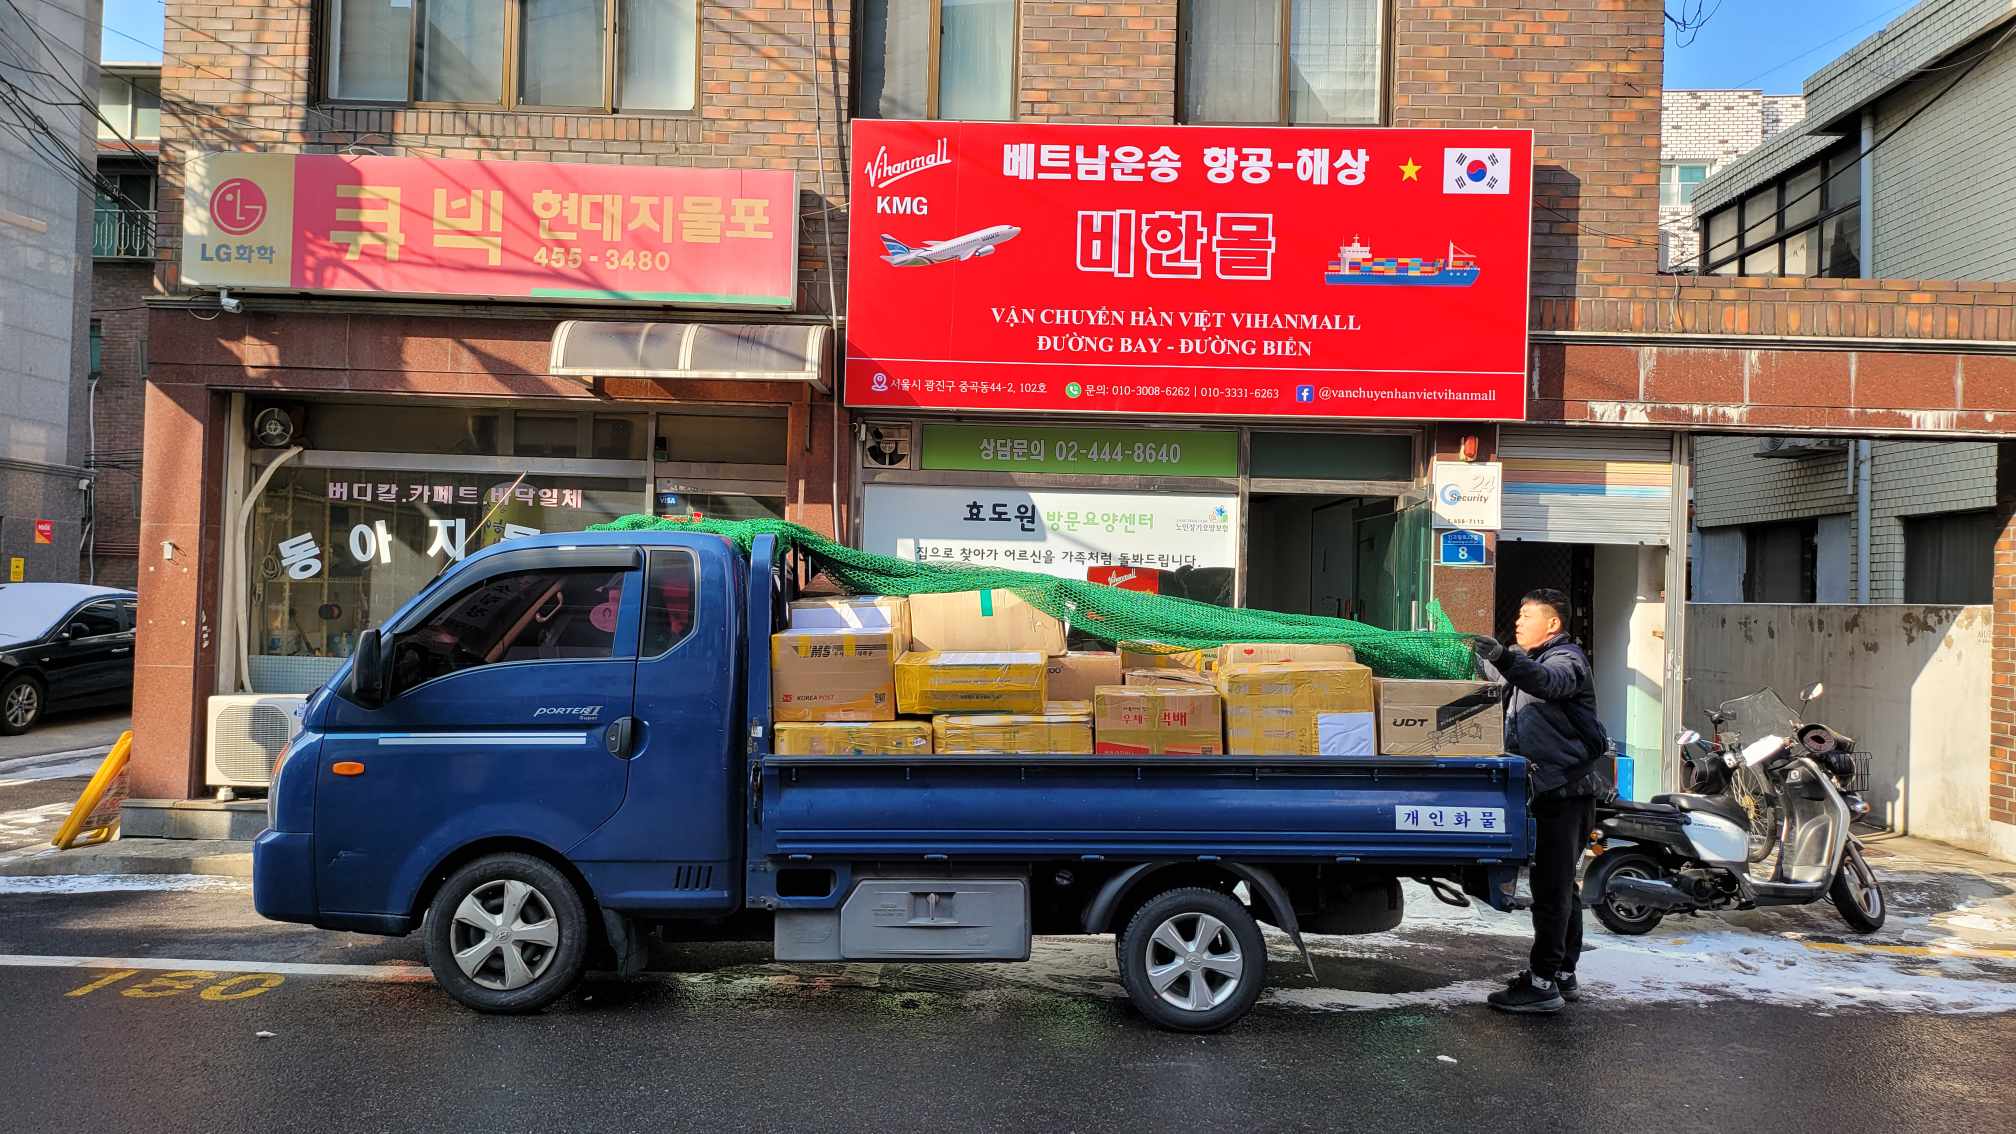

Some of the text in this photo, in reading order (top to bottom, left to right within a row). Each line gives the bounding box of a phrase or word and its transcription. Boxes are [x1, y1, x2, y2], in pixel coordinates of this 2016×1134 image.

[864, 137, 952, 189] Vihanmall
[1003, 143, 1370, 186] 베트남운송 항공-해상
[532, 189, 774, 244] 현대지물포
[876, 196, 928, 216] KMG
[200, 243, 276, 265] LG화학
[1077, 208, 1277, 281] 비한몰
[991, 305, 1036, 328] VẬN
[1130, 305, 1174, 328] HÀN
[1179, 309, 1226, 332] VIỆT
[1230, 312, 1362, 331] VIHANMALL
[1036, 331, 1115, 353] ĐƯỜNG
[1119, 336, 1163, 354] BAY
[1178, 334, 1257, 357] ĐƯỜNG
[889, 378, 922, 392] 서울시
[924, 379, 957, 392] 광진구
[1019, 383, 1048, 394] 102호
[1085, 384, 1110, 397] 문의:
[1111, 385, 1191, 397] 010-3008-6262
[1200, 387, 1280, 399] 010-3331-6263
[1318, 386, 1497, 402] @vanchuyenhanvietvihanmall
[979, 438, 1182, 465] 상담문의 02-444-8640
[660, 497, 676, 505] VISA
[1449, 490, 1489, 504] Security
[963, 500, 1155, 534] 효도원 방문요양센터
[916, 546, 1202, 568] 집으로 찾아가 어르신을 가족처럼 돌봐드립니다.
[1458, 545, 1468, 560] 8
[1392, 718, 1429, 728] UDT
[1403, 809, 1497, 829] 개인화물
